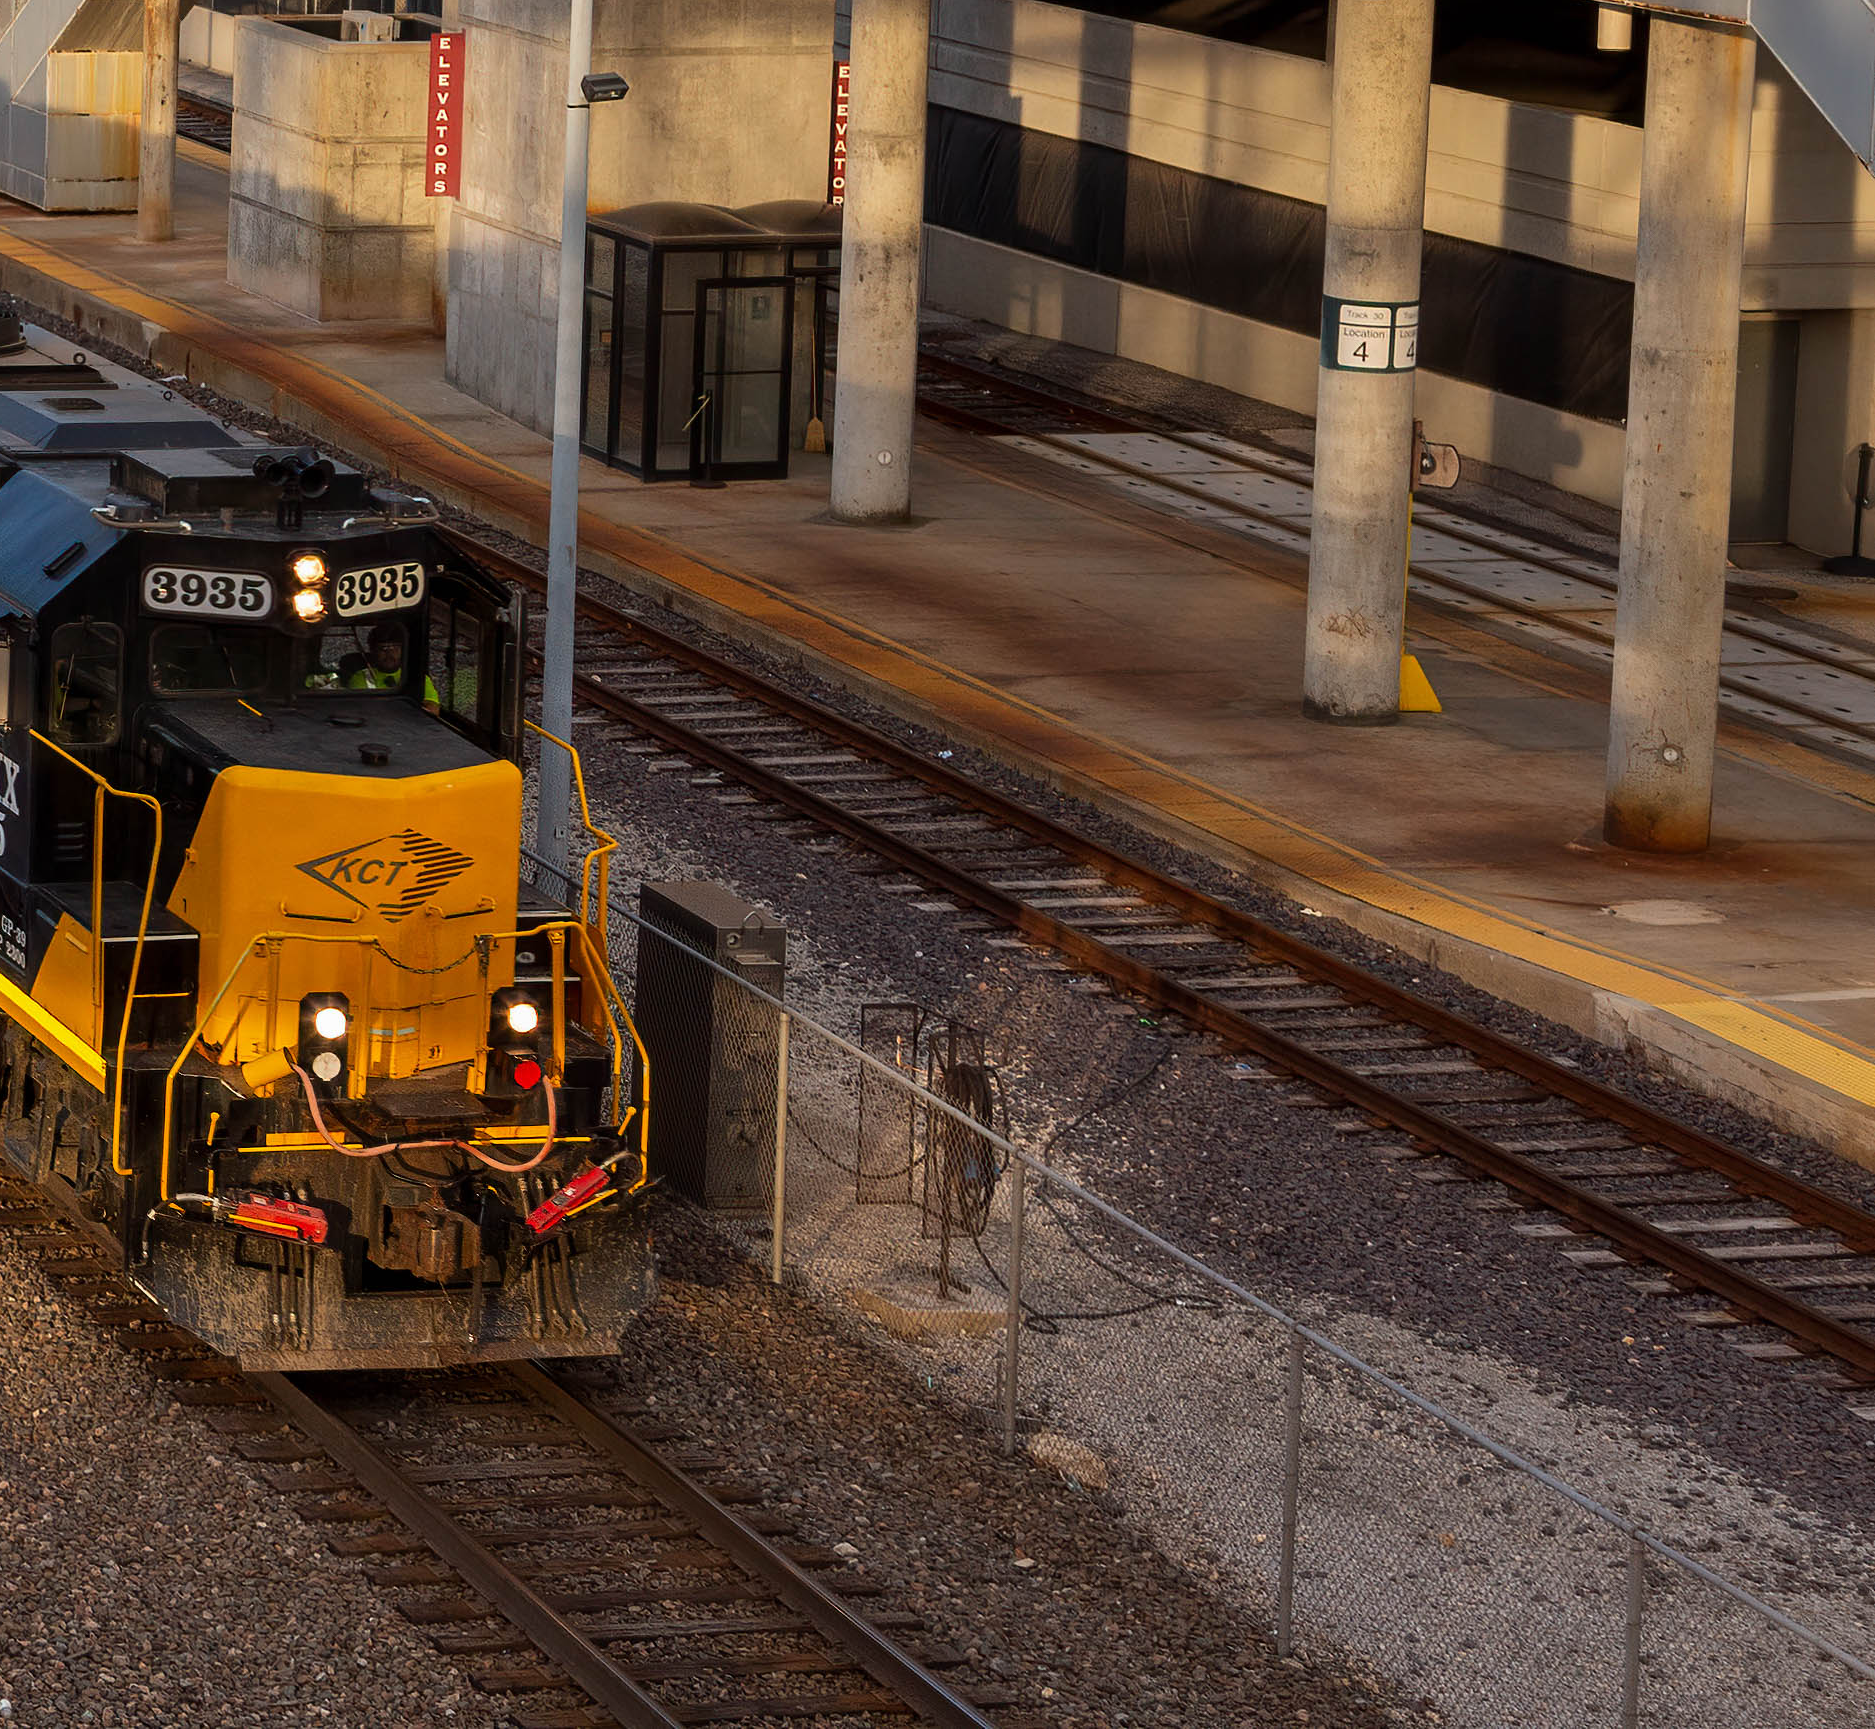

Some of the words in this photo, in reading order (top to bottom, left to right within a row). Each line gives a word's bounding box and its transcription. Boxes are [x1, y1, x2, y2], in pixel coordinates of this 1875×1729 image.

[433, 37, 451, 193] ELEVATORS
[832, 66, 850, 207] ELEVATOR
[1343, 327, 1386, 339] Location
[1353, 341, 1369, 362] 4
[151, 570, 266, 611] 3935
[338, 564, 420, 610] 3935
[330, 857, 408, 886] KCT
